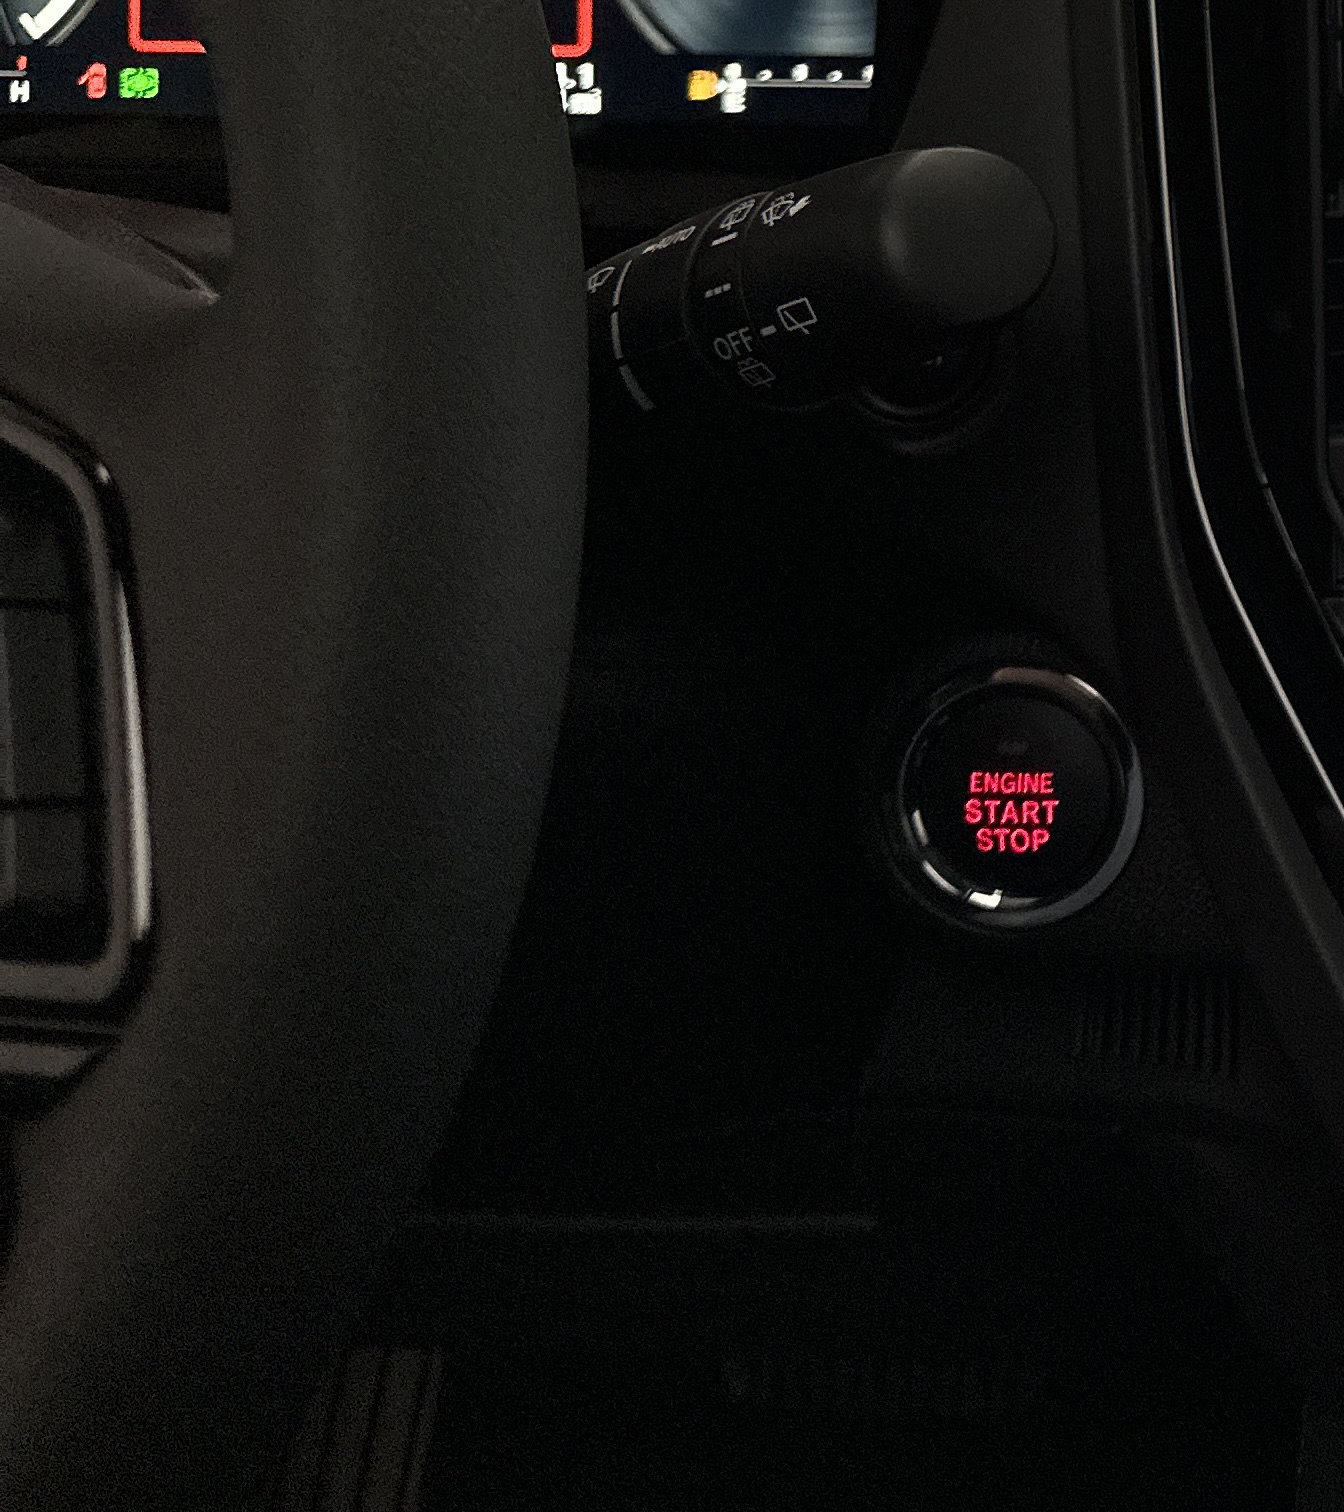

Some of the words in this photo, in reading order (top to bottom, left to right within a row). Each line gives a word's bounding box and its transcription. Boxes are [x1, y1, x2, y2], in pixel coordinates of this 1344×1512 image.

[8, 79, 31, 104] H
[712, 326, 753, 361] OFF
[969, 771, 1055, 795] ENGINE
[964, 798, 1061, 825] START
[975, 827, 1051, 854] STOP
